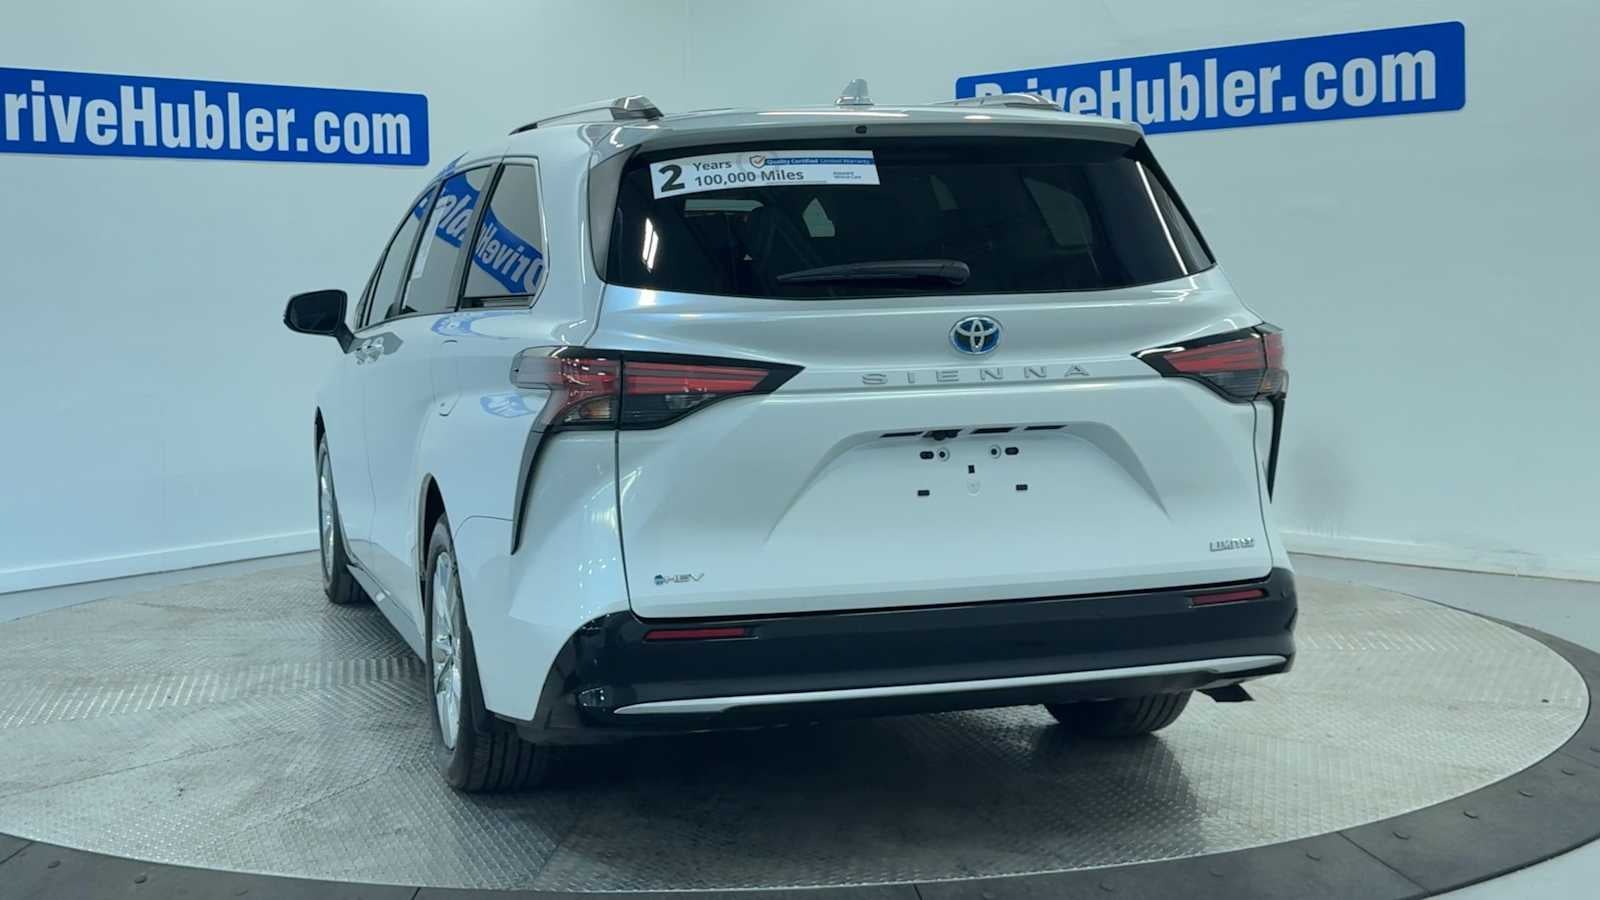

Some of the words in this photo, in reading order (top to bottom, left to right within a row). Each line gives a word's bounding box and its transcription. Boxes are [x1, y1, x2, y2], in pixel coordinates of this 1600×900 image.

[975, 49, 1436, 124] veHubler.com
[692, 160, 732, 172] Years
[658, 164, 686, 193] 2
[694, 172, 757, 187] 100,000
[761, 170, 804, 181] Miles
[862, 364, 1090, 385] SIENNA
